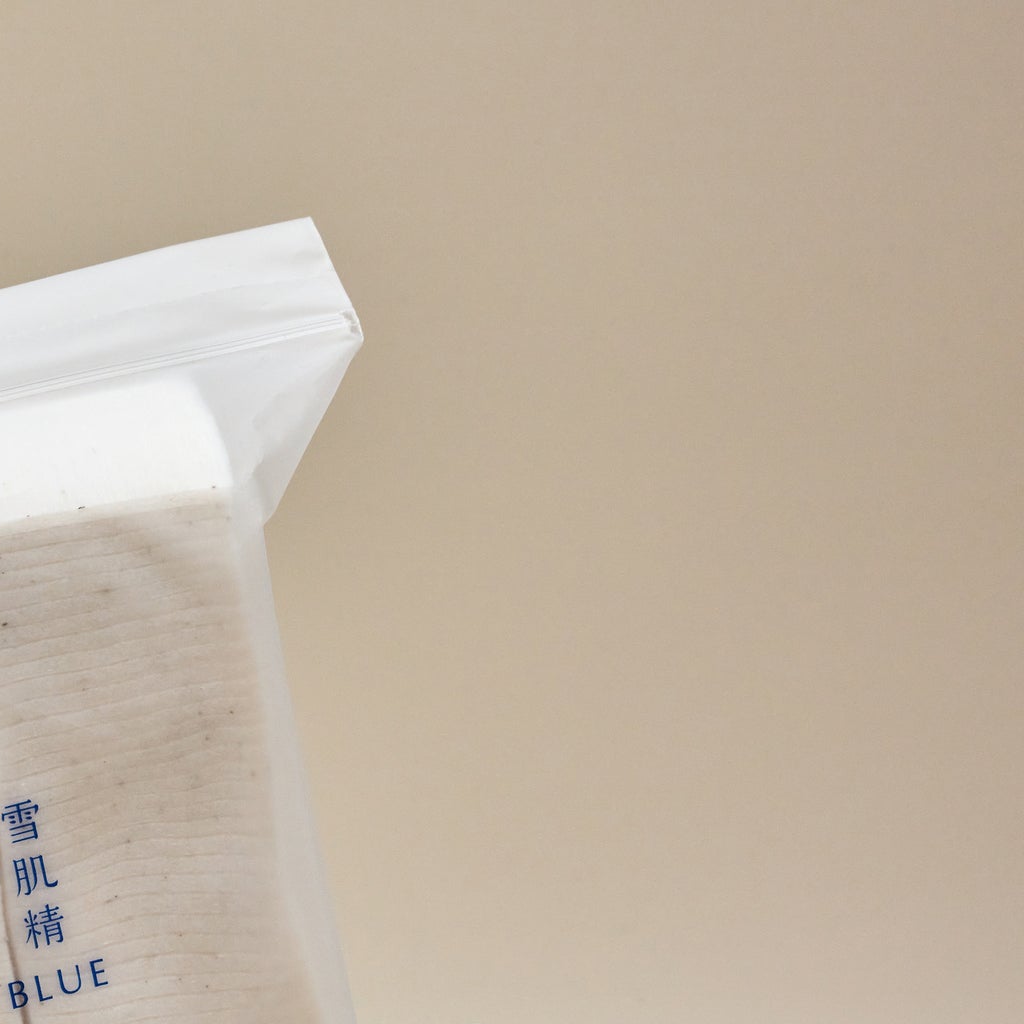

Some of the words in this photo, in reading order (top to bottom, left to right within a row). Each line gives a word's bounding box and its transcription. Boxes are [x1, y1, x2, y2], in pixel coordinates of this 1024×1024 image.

[1, 799, 65, 949] 雪肌精
[8, 958, 109, 1009] BLUE
